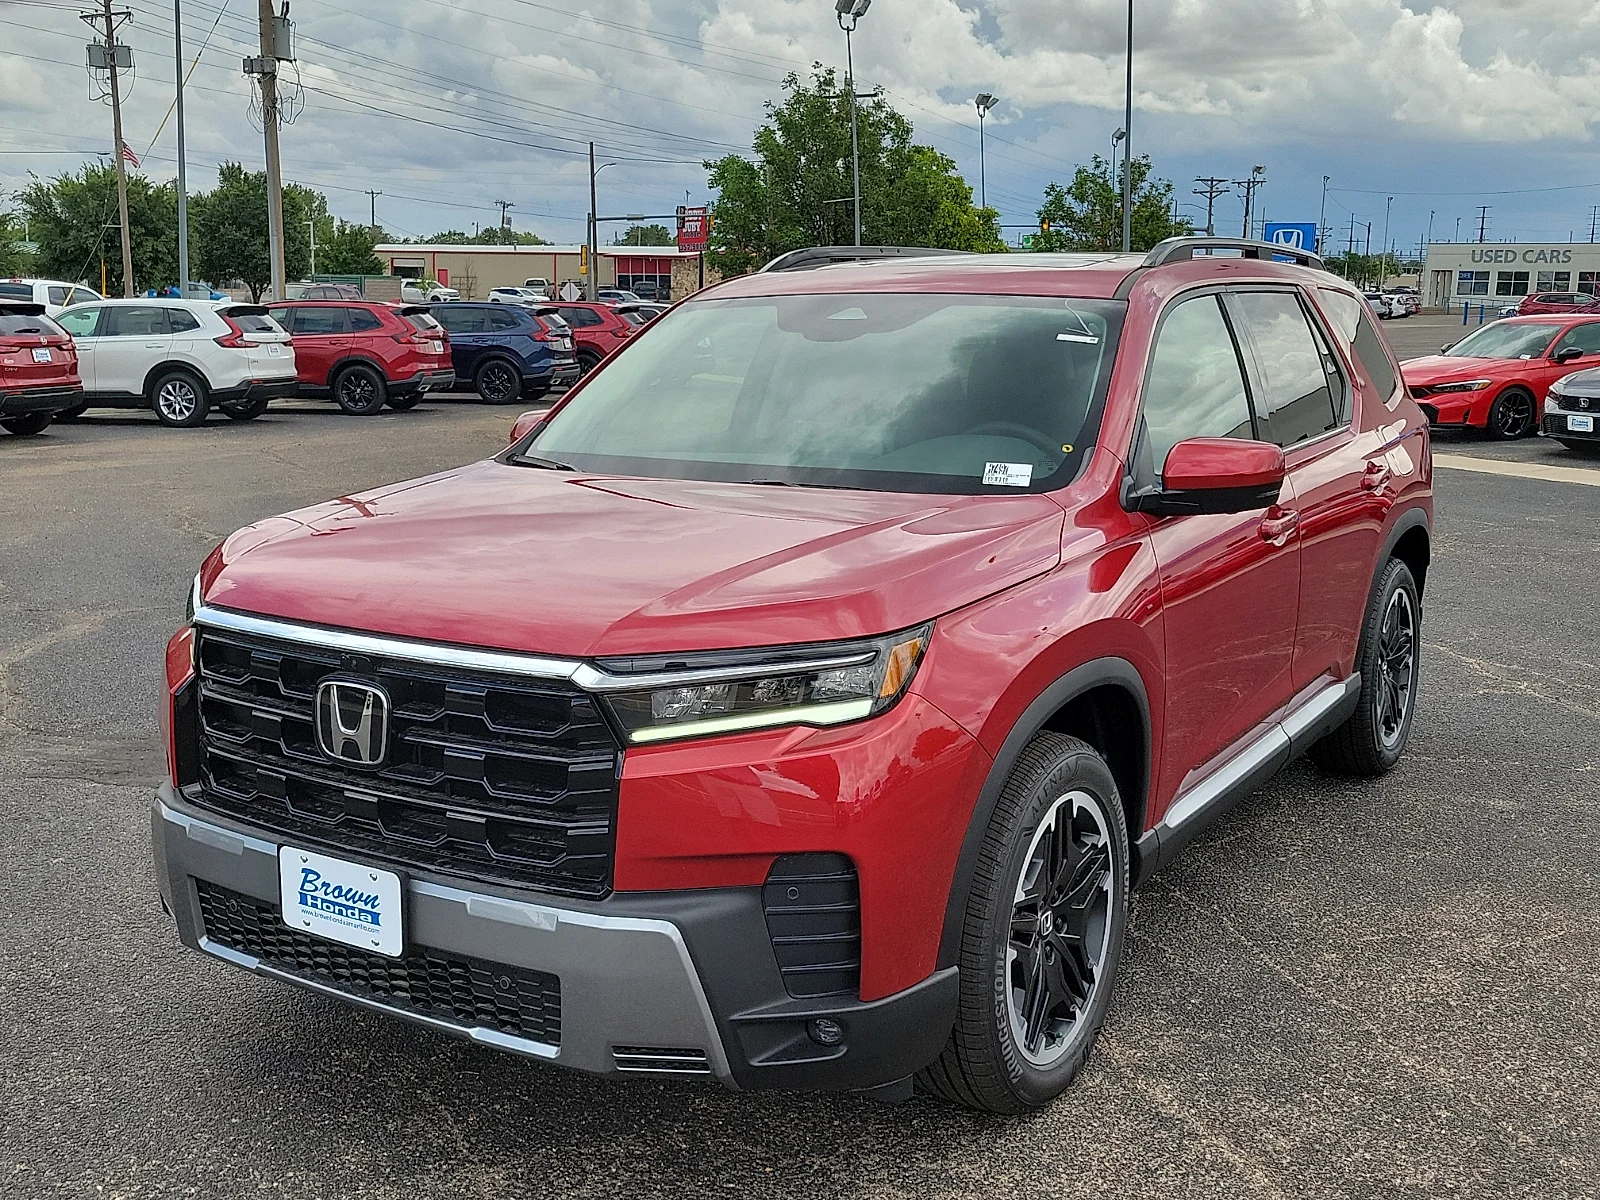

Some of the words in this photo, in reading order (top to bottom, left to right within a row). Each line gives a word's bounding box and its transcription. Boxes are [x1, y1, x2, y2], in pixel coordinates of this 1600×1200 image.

[1471, 249, 1517, 264] USED
[1522, 249, 1572, 264] CARS
[1110, 785, 1129, 913] BRIDGESTONE
[299, 867, 381, 909] Brown
[307, 895, 373, 924] Honda
[994, 944, 1024, 1084] BRIDGESTONE
